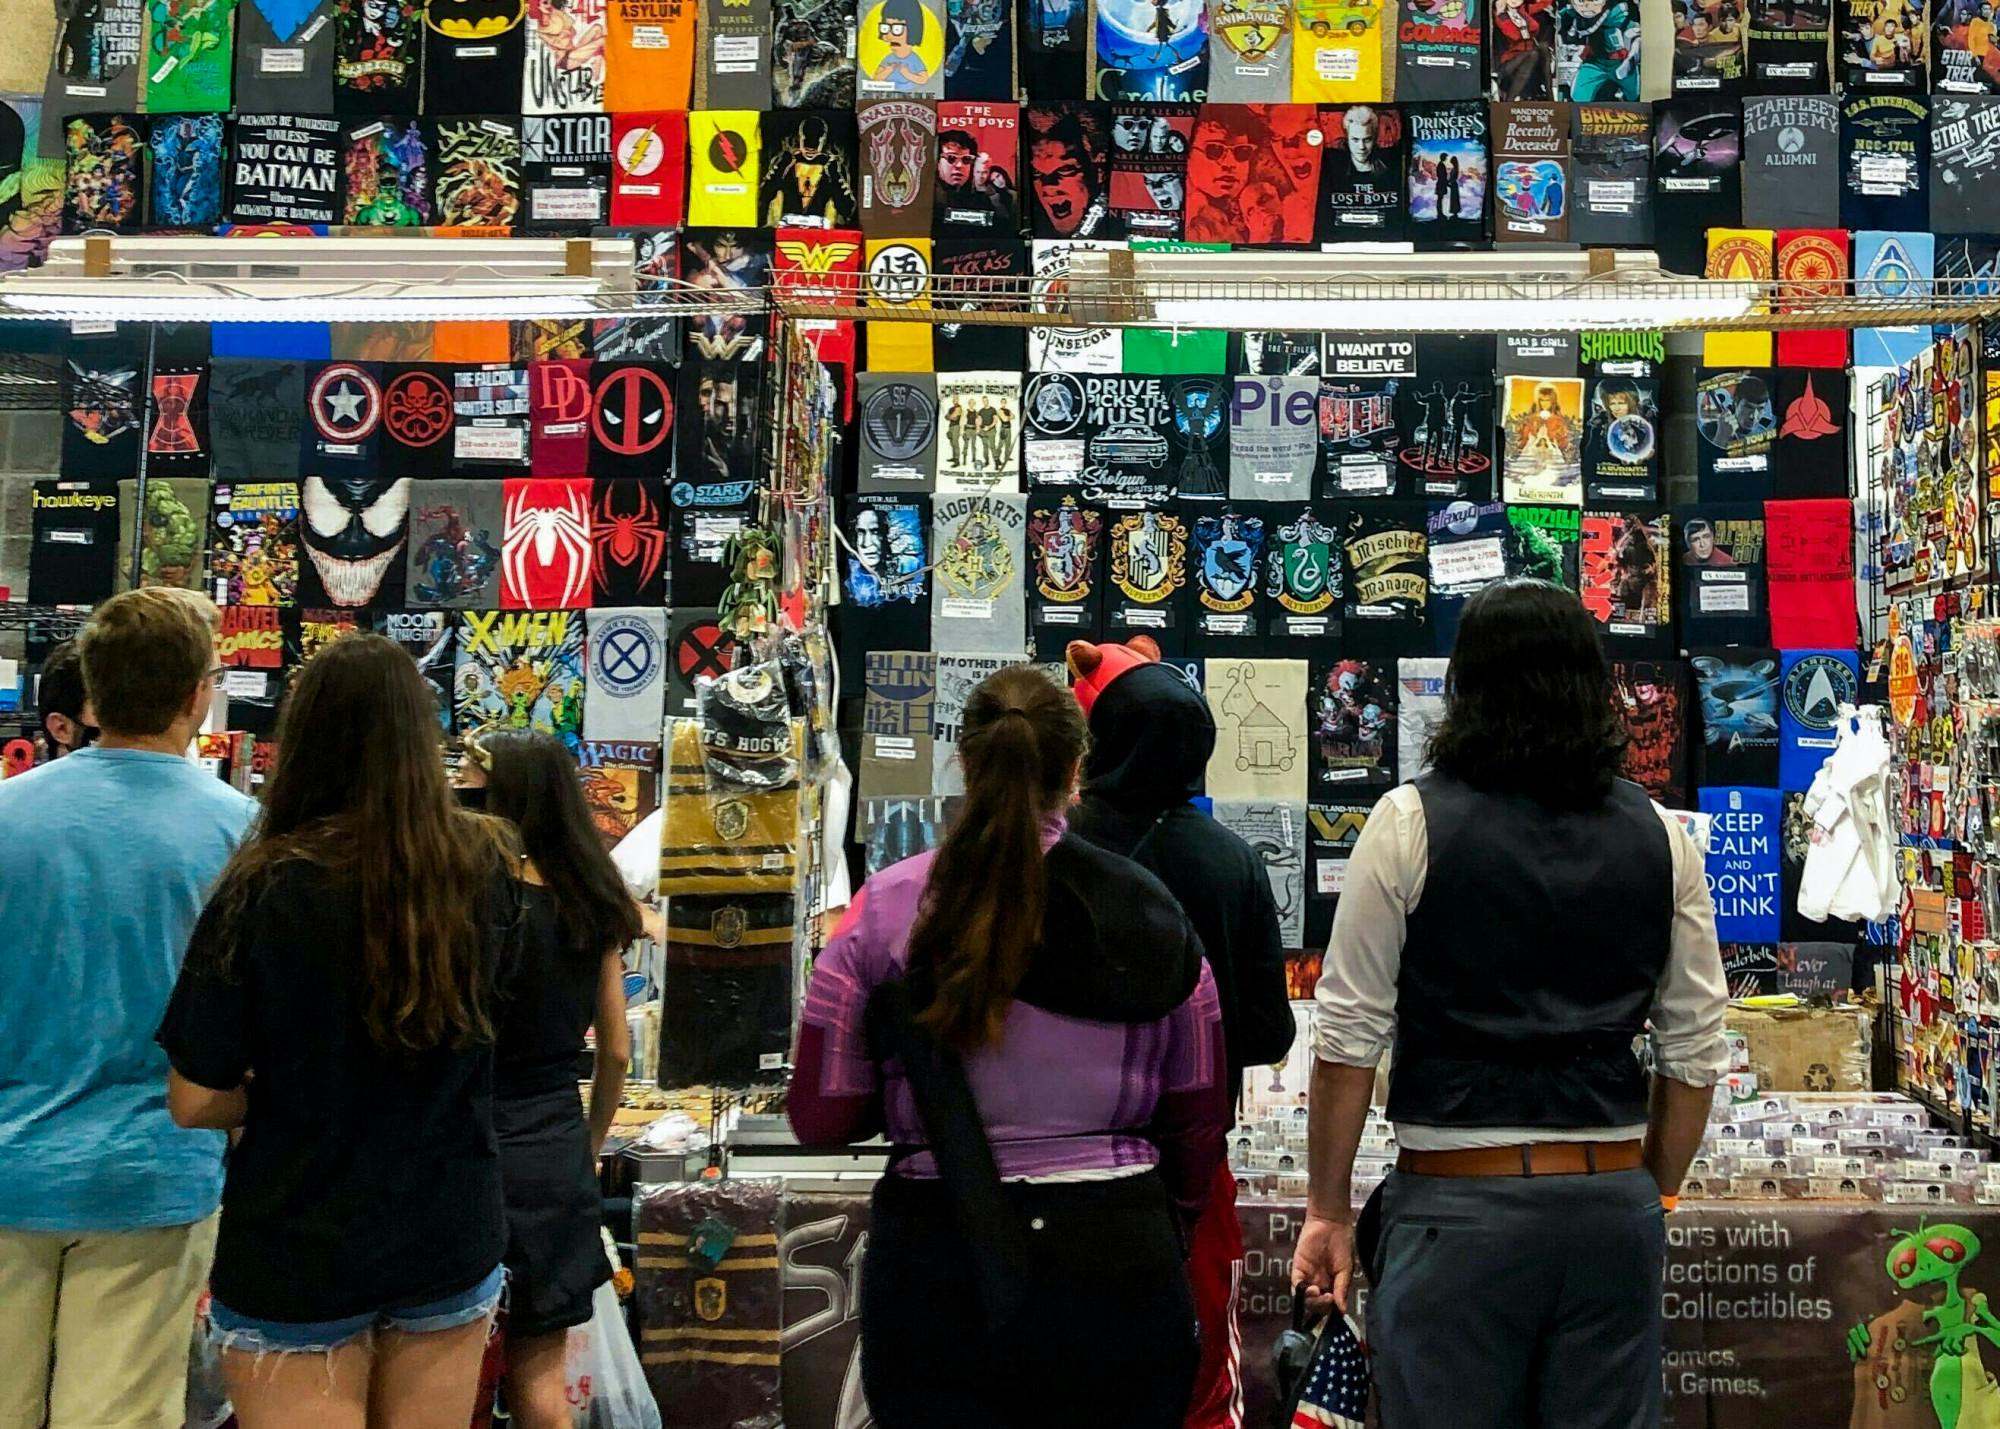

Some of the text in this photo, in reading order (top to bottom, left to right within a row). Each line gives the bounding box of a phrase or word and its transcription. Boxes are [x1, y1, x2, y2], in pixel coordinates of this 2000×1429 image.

[104, 8, 141, 22] HAVE
[620, 4, 682, 17] ASYLUM
[1850, 1, 1876, 17] TREK
[718, 15, 755, 25] WAYNE
[1215, 10, 1284, 27] ANIMANIAC
[93, 22, 141, 37] FAILED
[1400, 22, 1481, 44] COURAGE
[107, 37, 140, 51] THIS
[106, 51, 138, 65] CITY
[1941, 50, 1973, 67] STAR
[1945, 65, 1976, 82] TREK
[859, 102, 935, 127] WARRIORS
[963, 105, 992, 117] THE
[1111, 105, 1146, 116] SLEEP
[1150, 107, 1172, 117] ALL
[1433, 111, 1456, 119] THE
[1510, 108, 1555, 116] HANDBOOK
[1579, 106, 1644, 123] BACK
[1743, 98, 1839, 123] STARFLEET
[1869, 96, 1929, 120] ENTERPRISE
[238, 114, 278, 127] ALWAYS
[279, 115, 292, 127] BE
[941, 116, 1015, 130] LOST BOYS
[1411, 113, 1487, 136] PRINCESS
[1516, 114, 1550, 123] FOR THE
[1744, 112, 1839, 138] ACADEMY
[1930, 102, 2000, 152] STAR TRE
[266, 129, 311, 143] UNLESS
[544, 116, 611, 154] STAR
[1420, 129, 1471, 141] BRIDE
[1507, 123, 1557, 139] Recently
[1594, 123, 1650, 136] FUTURE
[1504, 137, 1560, 152] Deceased
[1854, 138, 1916, 152] NCC-1701
[239, 143, 337, 166] YOU CAN BE
[1764, 152, 1817, 167] ALUMNI
[235, 163, 338, 191] BATMAN
[1353, 183, 1374, 195] THE
[1331, 192, 1398, 206] LOST BOYS
[233, 203, 334, 222] ALWAYS BE BATMAN
[985, 253, 1013, 270] ASS
[1029, 326, 1112, 350] COUNSELOR
[1507, 336, 1569, 348] BAR GRILL
[1328, 342, 1413, 357] I WANT TO
[1579, 332, 1666, 365] SHADOWS
[1336, 358, 1405, 374] BELIEVE
[1086, 378, 1162, 397] DRIVE
[1087, 394, 1168, 410] PICKS TH
[1231, 380, 1316, 427] Pie
[1086, 408, 1172, 427] MUSIC
[1745, 429, 1777, 446] YOU'RE
[1081, 465, 1148, 491] Shotgun
[696, 484, 745, 497] STARK
[1126, 484, 1169, 493] SHUTS HIS
[32, 489, 117, 512] hawkeye
[933, 496, 1024, 530] HOGWARTS
[1506, 505, 1580, 529] GODZILLA
[1356, 534, 1423, 561] Mischief
[386, 613, 438, 628] MOON
[628, 620, 657, 647] SCHOOL
[214, 629, 284, 656] COMICS
[939, 657, 998, 669] MY OTHER
[972, 670, 982, 679] IS
[1307, 803, 1376, 814] WEYLAND-YUTAN
[1710, 813, 1764, 832] KEEP
[1708, 835, 1768, 855] CALM
[1725, 860, 1752, 870] AND
[1322, 874, 1336, 882] $28
[1704, 872, 1778, 893] DON'T
[1711, 896, 1776, 916] BLINK
[1777, 945, 1828, 975] Never
[1784, 971, 1837, 993] Laugh at
[1725, 1220, 1792, 1248] with
[1662, 1255, 1817, 1284] lections of
[1240, 1288, 1296, 1316] Scie
[1662, 1292, 1833, 1321] Collectibles
[1680, 1372, 1768, 1398] Games,
